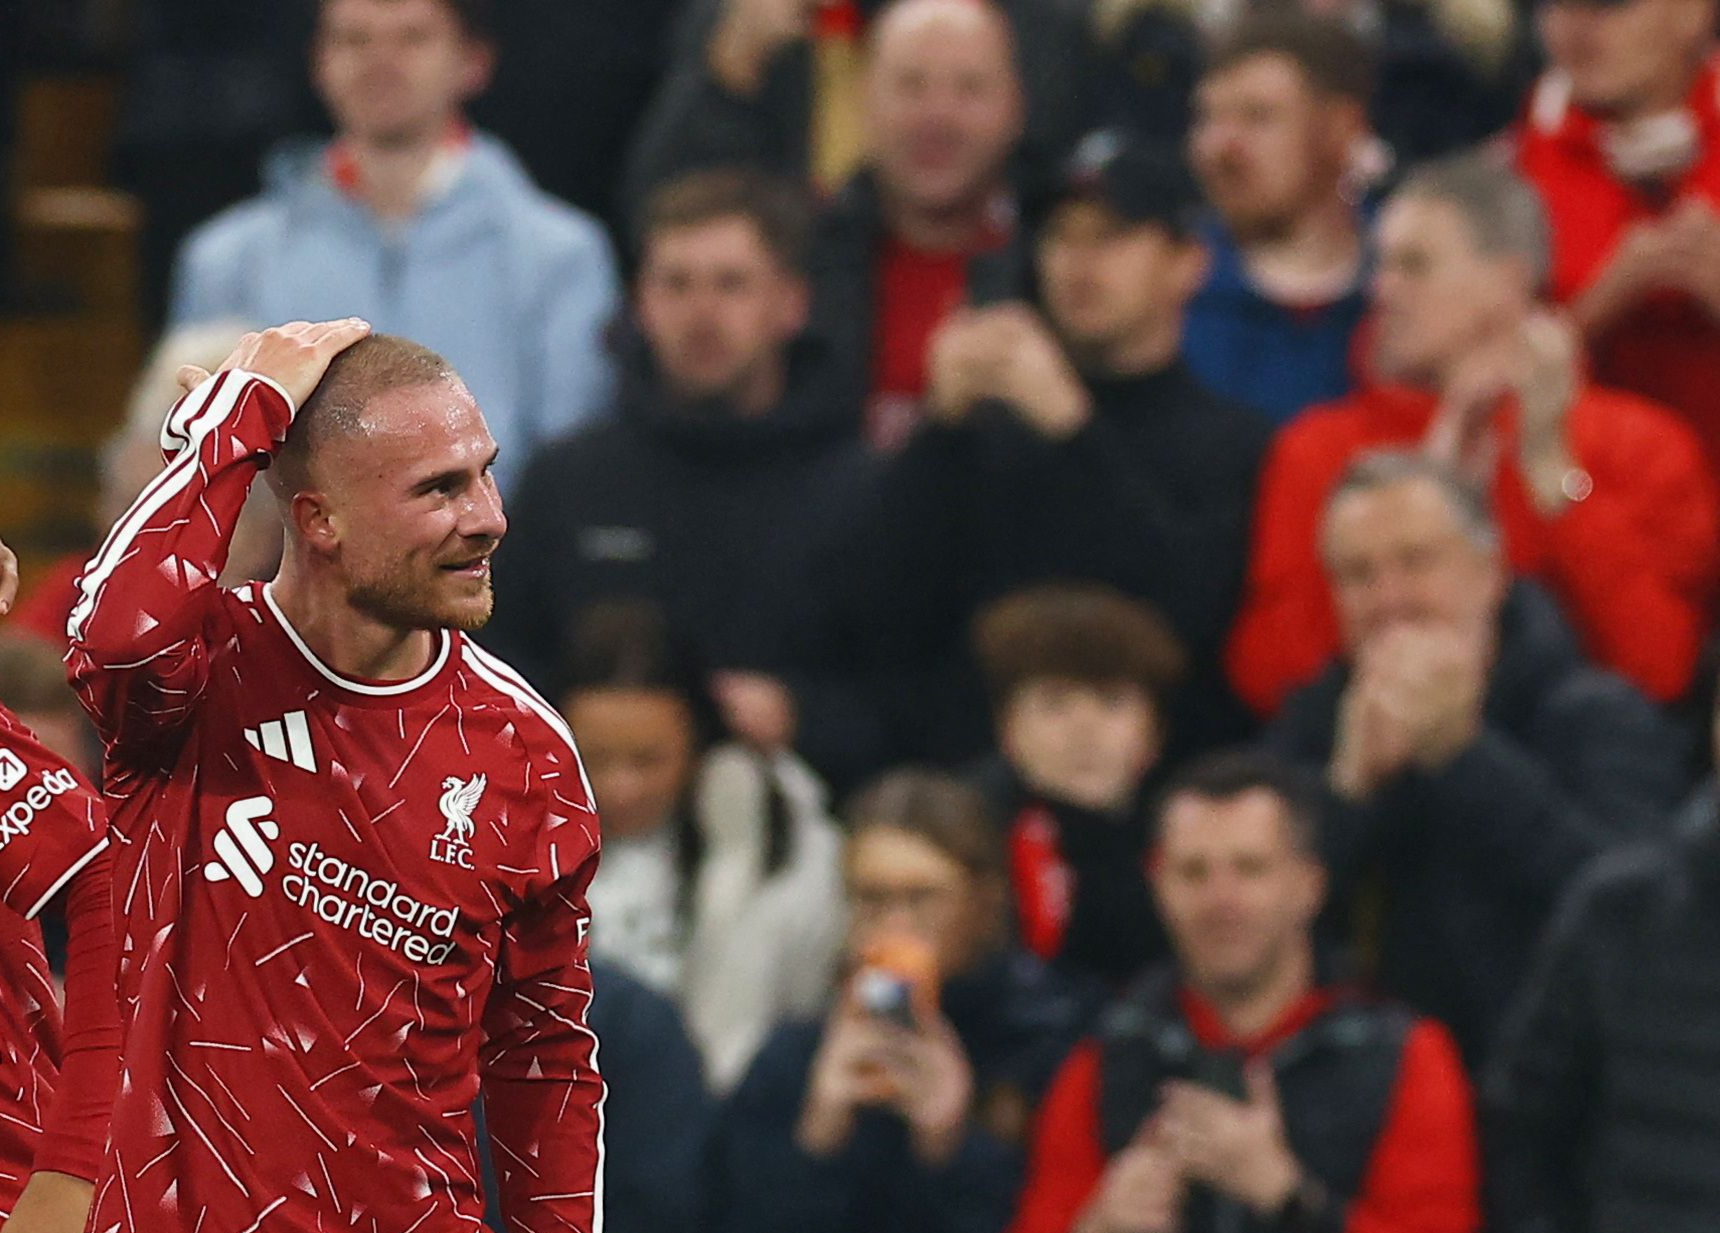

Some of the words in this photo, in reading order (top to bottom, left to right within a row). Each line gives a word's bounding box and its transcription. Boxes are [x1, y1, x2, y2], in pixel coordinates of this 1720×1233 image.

[289, 841, 459, 939] standard
[429, 841, 474, 870] L.F.C.
[282, 874, 456, 965] chartered
